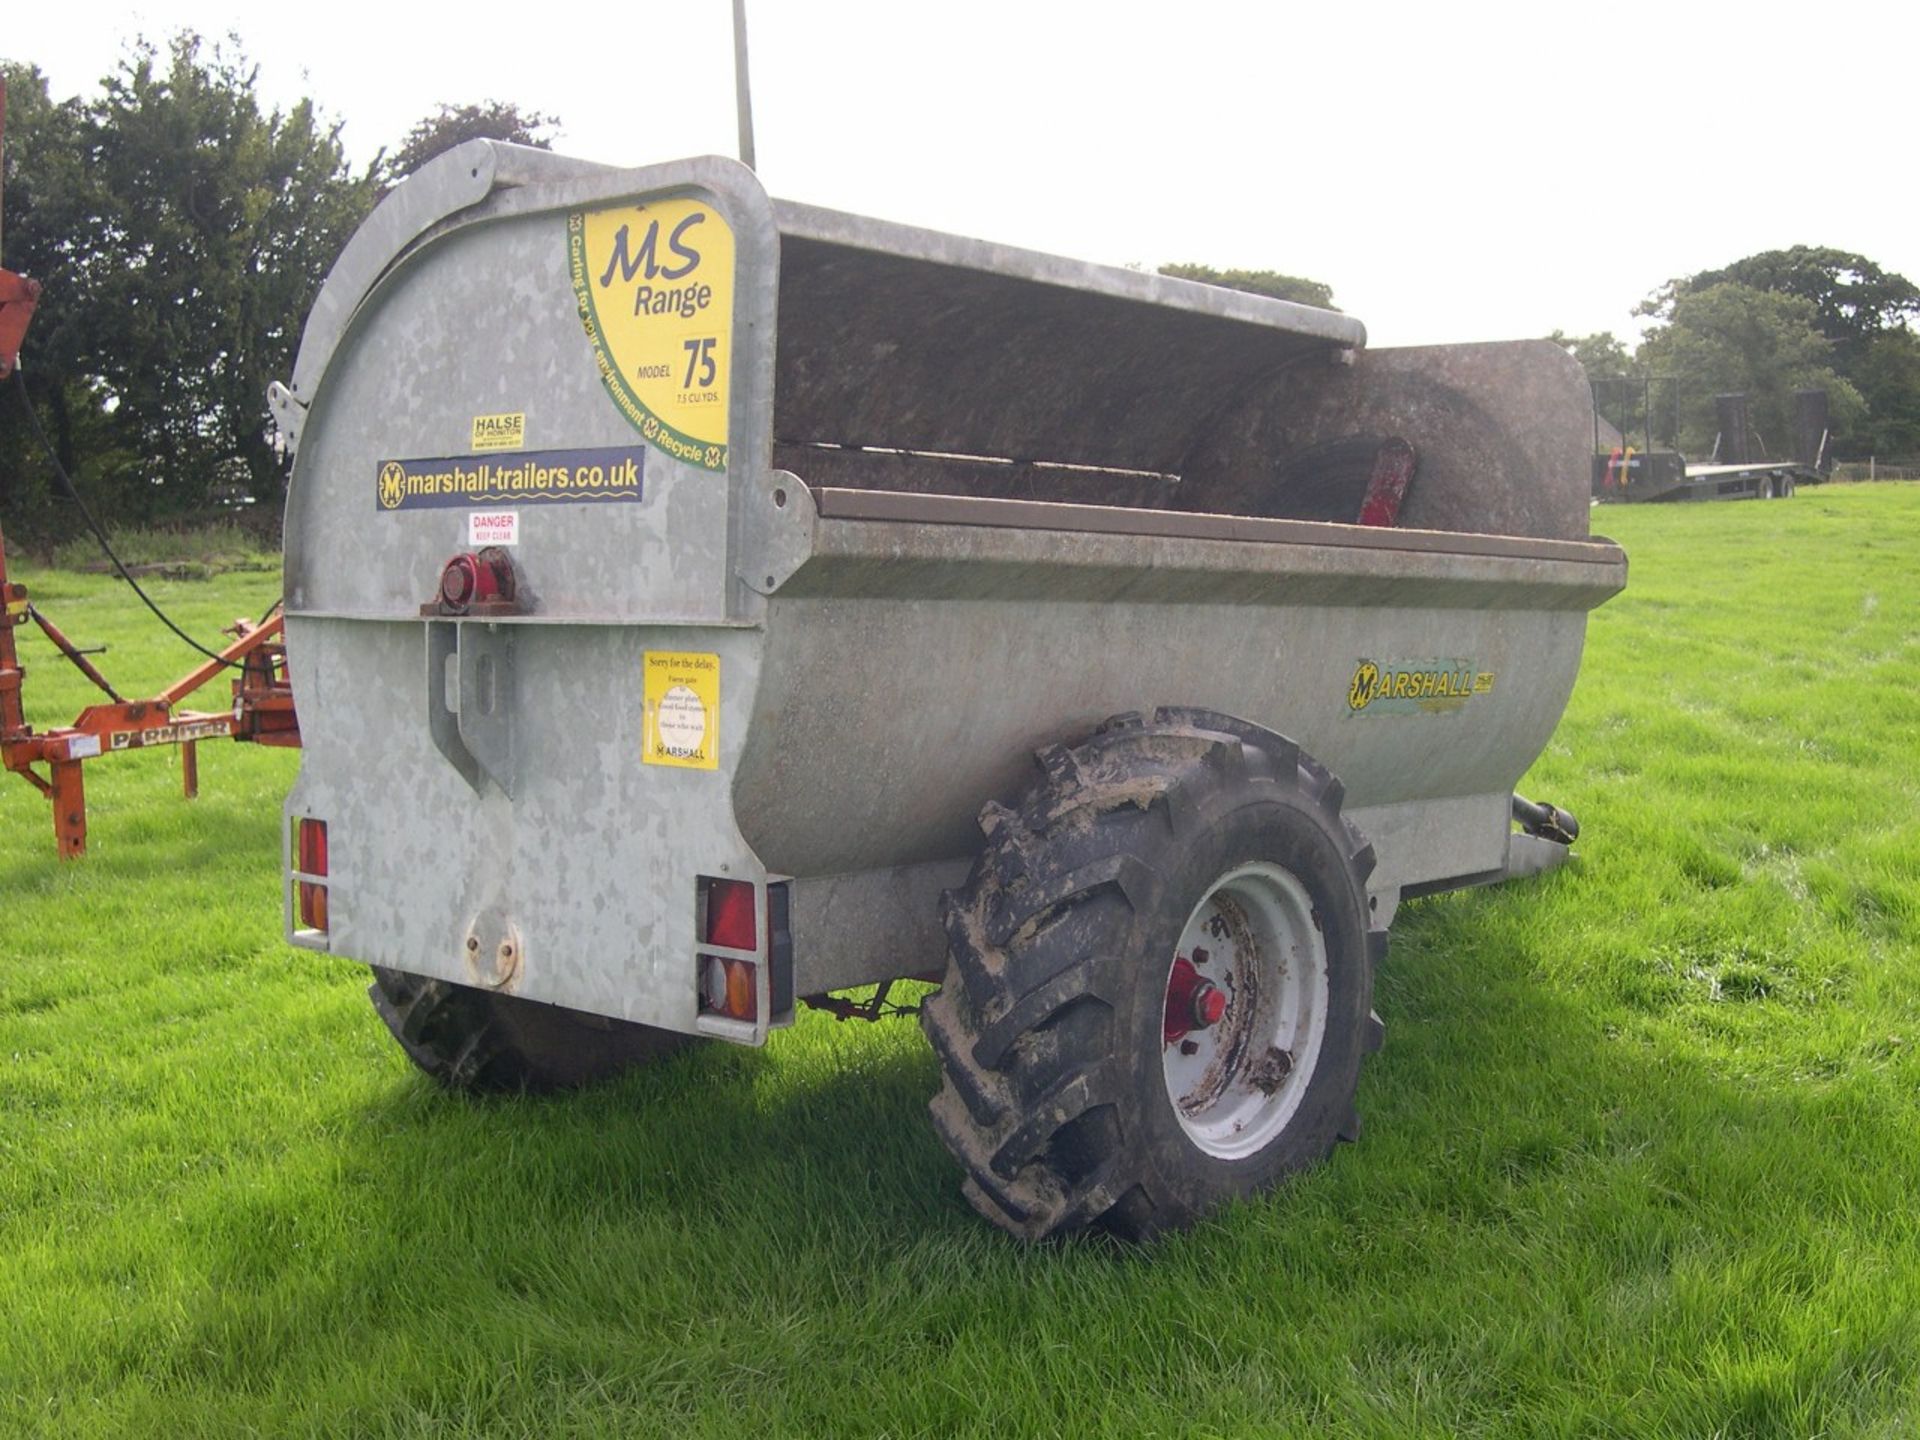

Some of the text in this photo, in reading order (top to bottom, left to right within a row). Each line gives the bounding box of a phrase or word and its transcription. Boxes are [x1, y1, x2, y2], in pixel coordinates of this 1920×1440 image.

[600, 212, 706, 289] MS
[634, 281, 712, 319] Range
[577, 290, 589, 315] for
[583, 315, 601, 350] your
[596, 349, 646, 426] environment
[657, 428, 704, 462] Recycle
[637, 366, 671, 380] MODEL
[683, 337, 717, 389] 75
[476, 415, 522, 430] HALSE
[407, 458, 639, 495] marshall-trailers.co.uk
[473, 515, 514, 528] DANGER
[649, 658, 668, 669] Sorry
[670, 659, 681, 668] for
[682, 659, 693, 668] the
[1350, 665, 1472, 705] MARSHALL
[113, 722, 227, 747] PRMITER
[656, 744, 705, 760] MARSHALL
